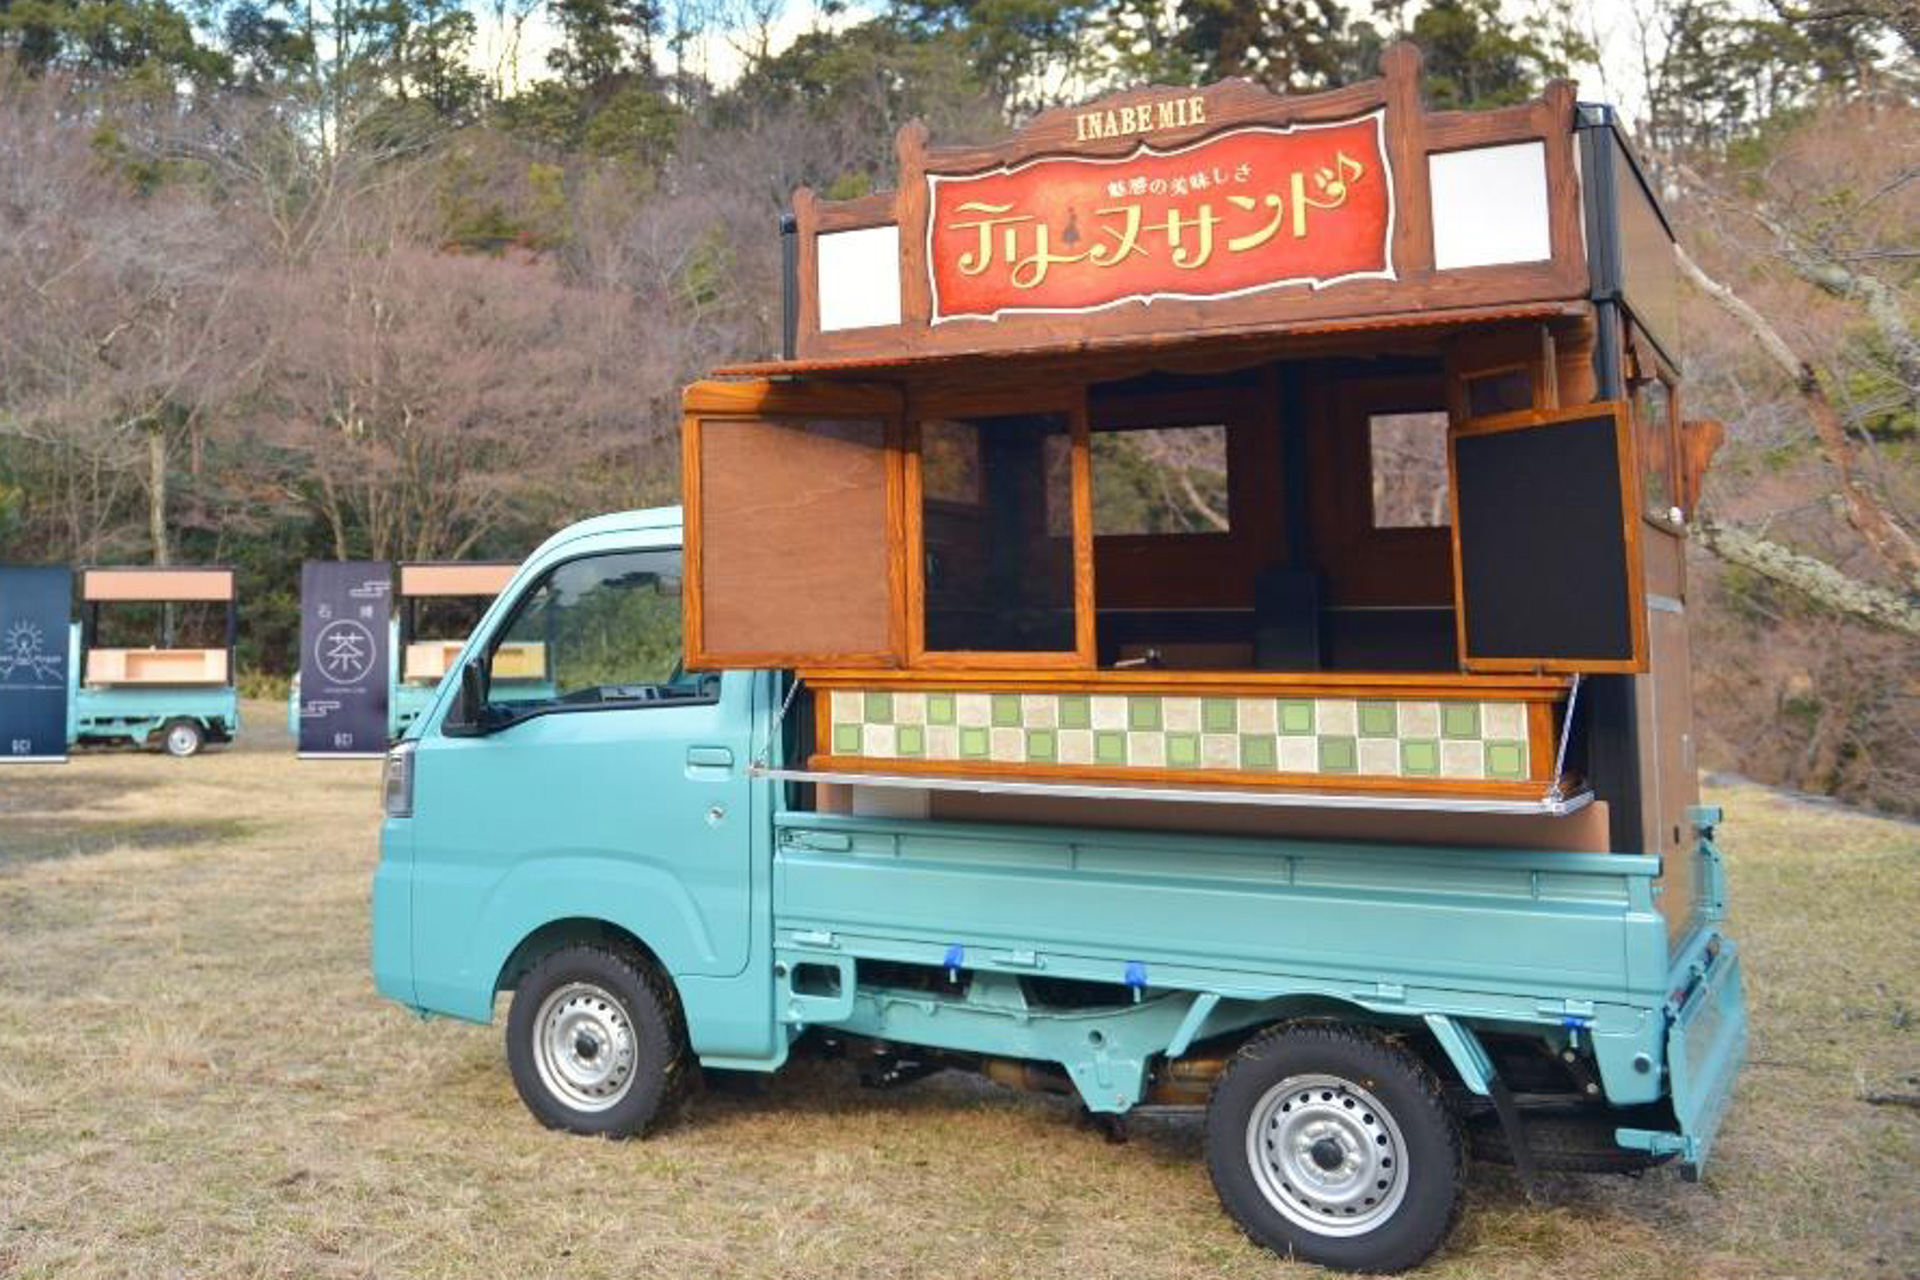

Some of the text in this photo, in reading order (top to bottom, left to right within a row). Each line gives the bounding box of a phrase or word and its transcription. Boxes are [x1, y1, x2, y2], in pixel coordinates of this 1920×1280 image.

[1077, 96, 1206, 141] INABE MIE
[327, 631, 364, 672] 茶
